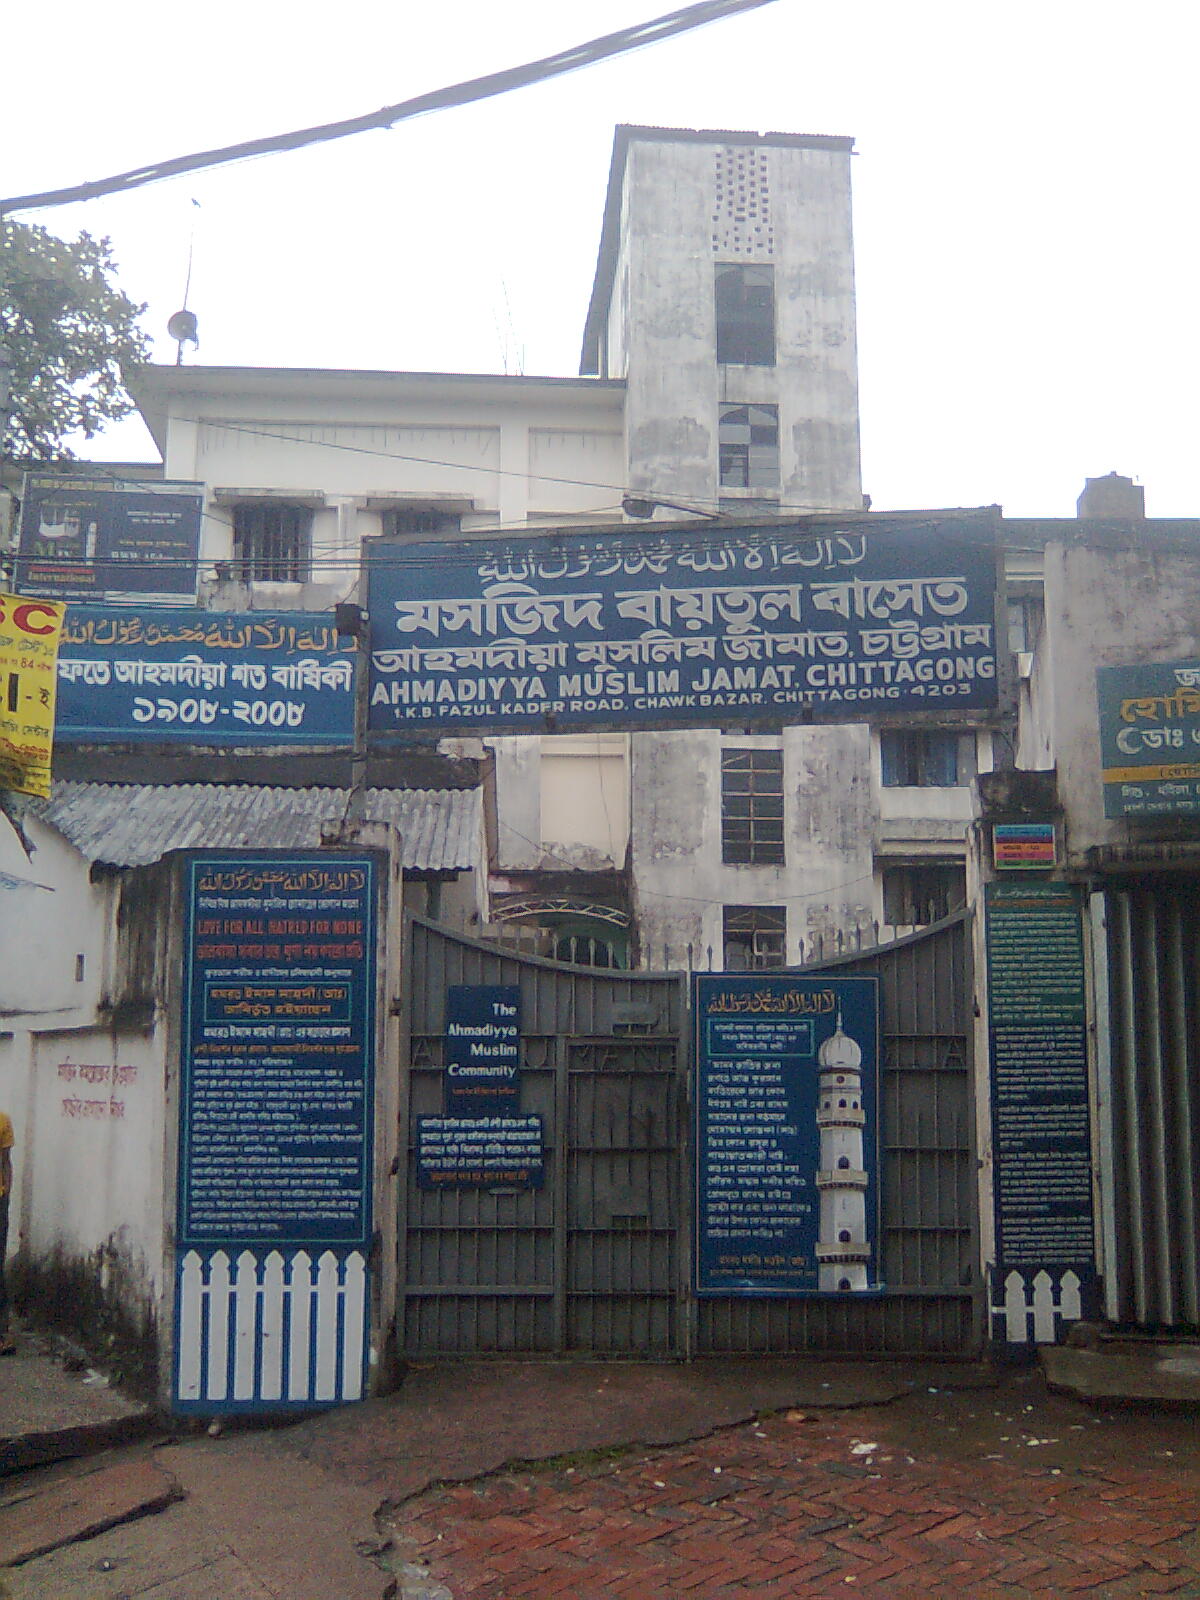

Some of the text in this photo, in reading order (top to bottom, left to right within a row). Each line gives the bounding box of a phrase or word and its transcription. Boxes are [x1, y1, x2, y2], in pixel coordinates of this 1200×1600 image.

[394, 576, 968, 637] মসজিদ বায়তুল বাসেত
[371, 637, 570, 673] আহমদীয়া
[574, 629, 717, 673] মুসলিম
[858, 620, 993, 659] চট্টগ্রাম
[114, 655, 228, 690] আহমদীয়া
[231, 663, 268, 690] শত
[371, 675, 547, 706] AHMADIYYA
[559, 669, 680, 698] MUSLIM
[806, 656, 995, 688] CHITTAGONG
[132, 697, 306, 727] ১৯০৮-২০০৮
[439, 704, 496, 717] FAZUL
[634, 694, 696, 710] CHAWK
[773, 687, 900, 704] CHITTAGONG
[910, 683, 972, 697] 4203
[224, 920, 244, 934] FOR
[246, 920, 265, 934] ALL
[309, 920, 330, 934] FOR
[492, 1003, 517, 1016] The
[448, 1023, 518, 1039] Ahmadiyya
[470, 1043, 518, 1057] Muslim
[448, 1063, 517, 1078] Community
